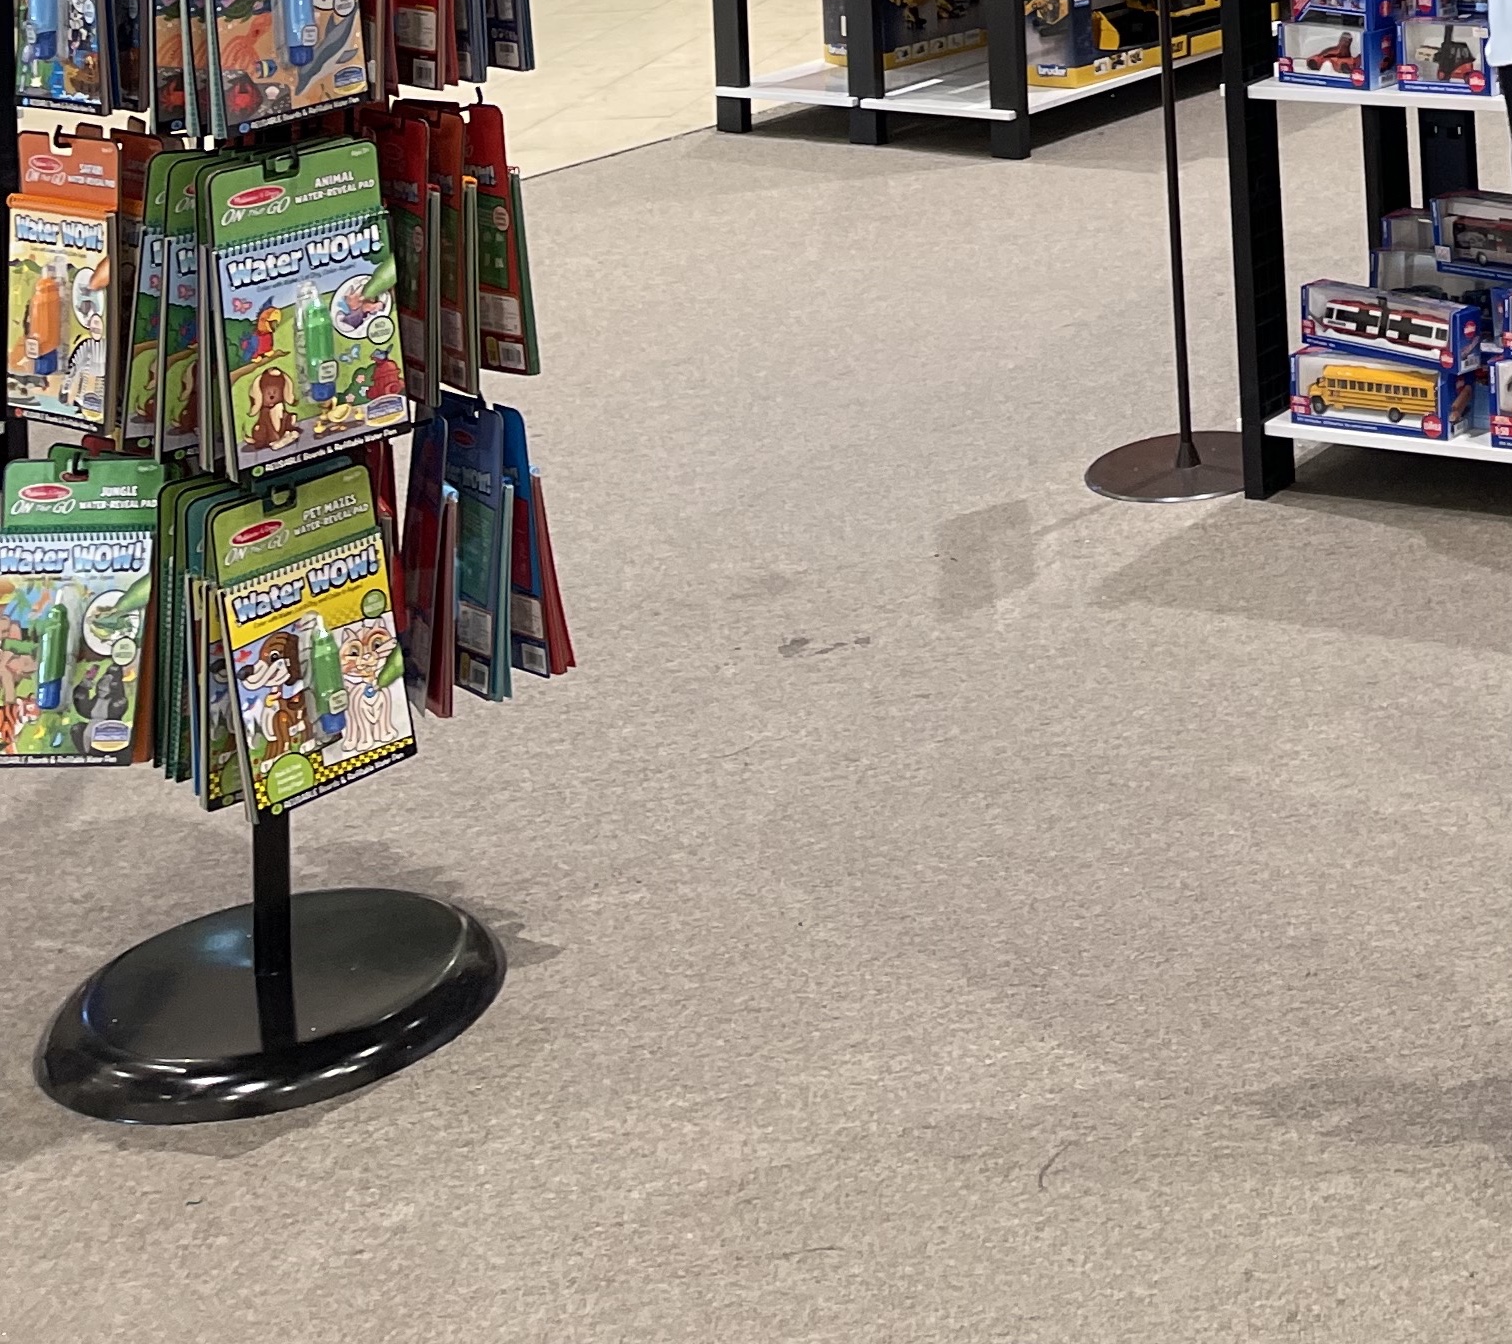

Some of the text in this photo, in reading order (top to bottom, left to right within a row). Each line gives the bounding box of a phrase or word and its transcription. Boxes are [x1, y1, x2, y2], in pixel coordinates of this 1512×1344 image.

[314, 170, 354, 189] ANIMAL
[358, 178, 375, 190] PAD
[221, 195, 291, 227] ON GO
[14, 214, 59, 247] Water
[226, 248, 304, 290] Water
[305, 223, 385, 270] WOW!
[100, 485, 138, 499] JUNGLE
[140, 498, 158, 510] PAD
[11, 499, 35, 516] ON
[52, 498, 76, 515] GO
[303, 493, 357, 521] PET MAZES
[0, 539, 147, 576] Water WOW!
[233, 543, 381, 626] Water WOW!
